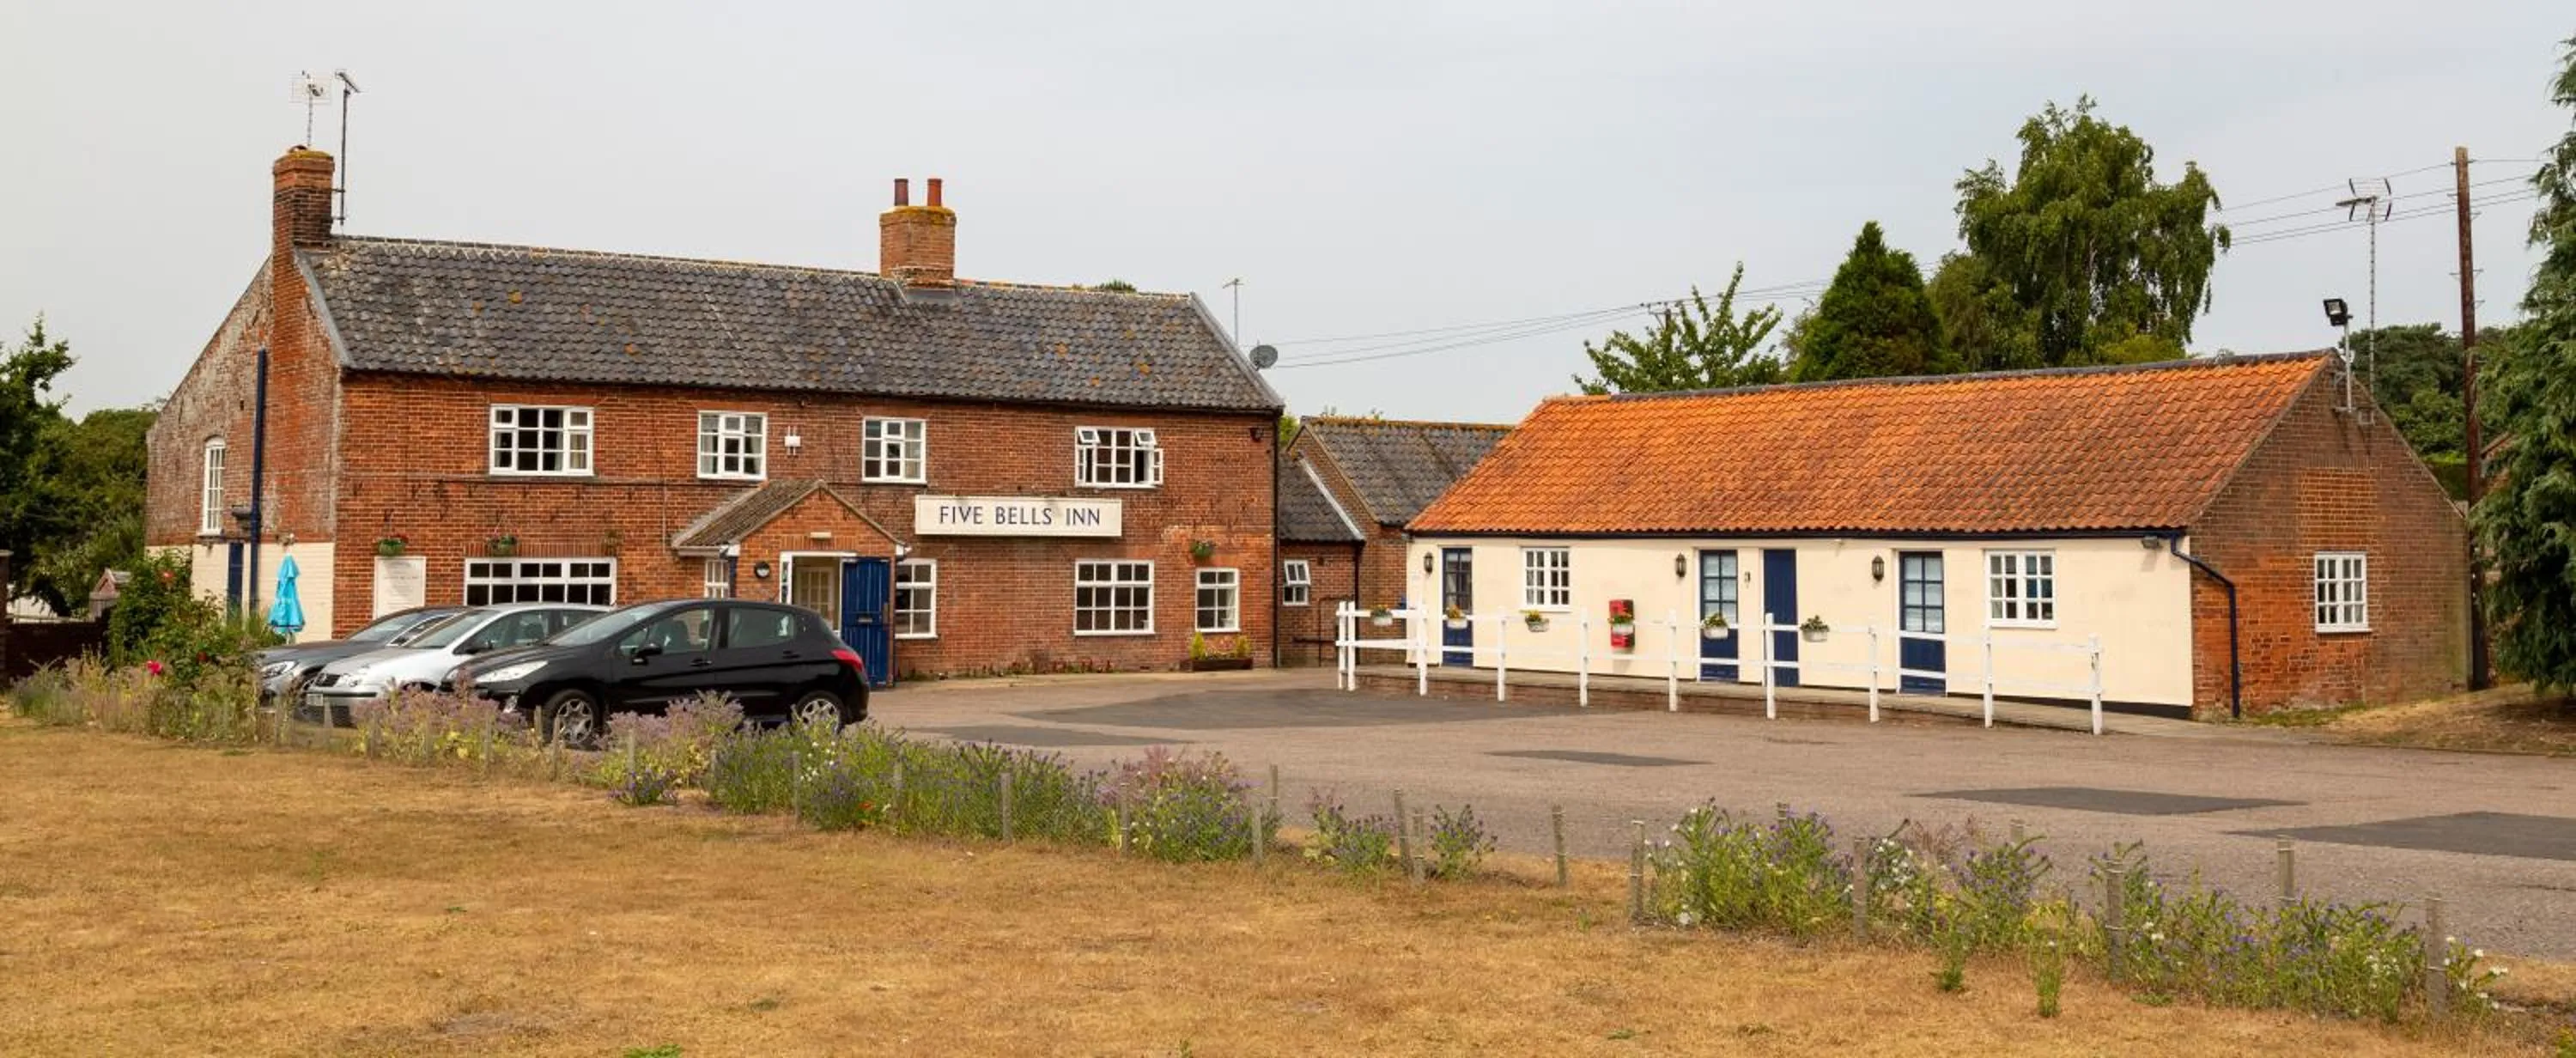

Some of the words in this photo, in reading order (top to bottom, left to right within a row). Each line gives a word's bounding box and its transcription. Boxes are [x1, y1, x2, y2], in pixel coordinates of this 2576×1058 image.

[939, 506, 983, 525] FIVE
[994, 506, 1053, 526] BELLS
[1066, 508, 1101, 526] INN
